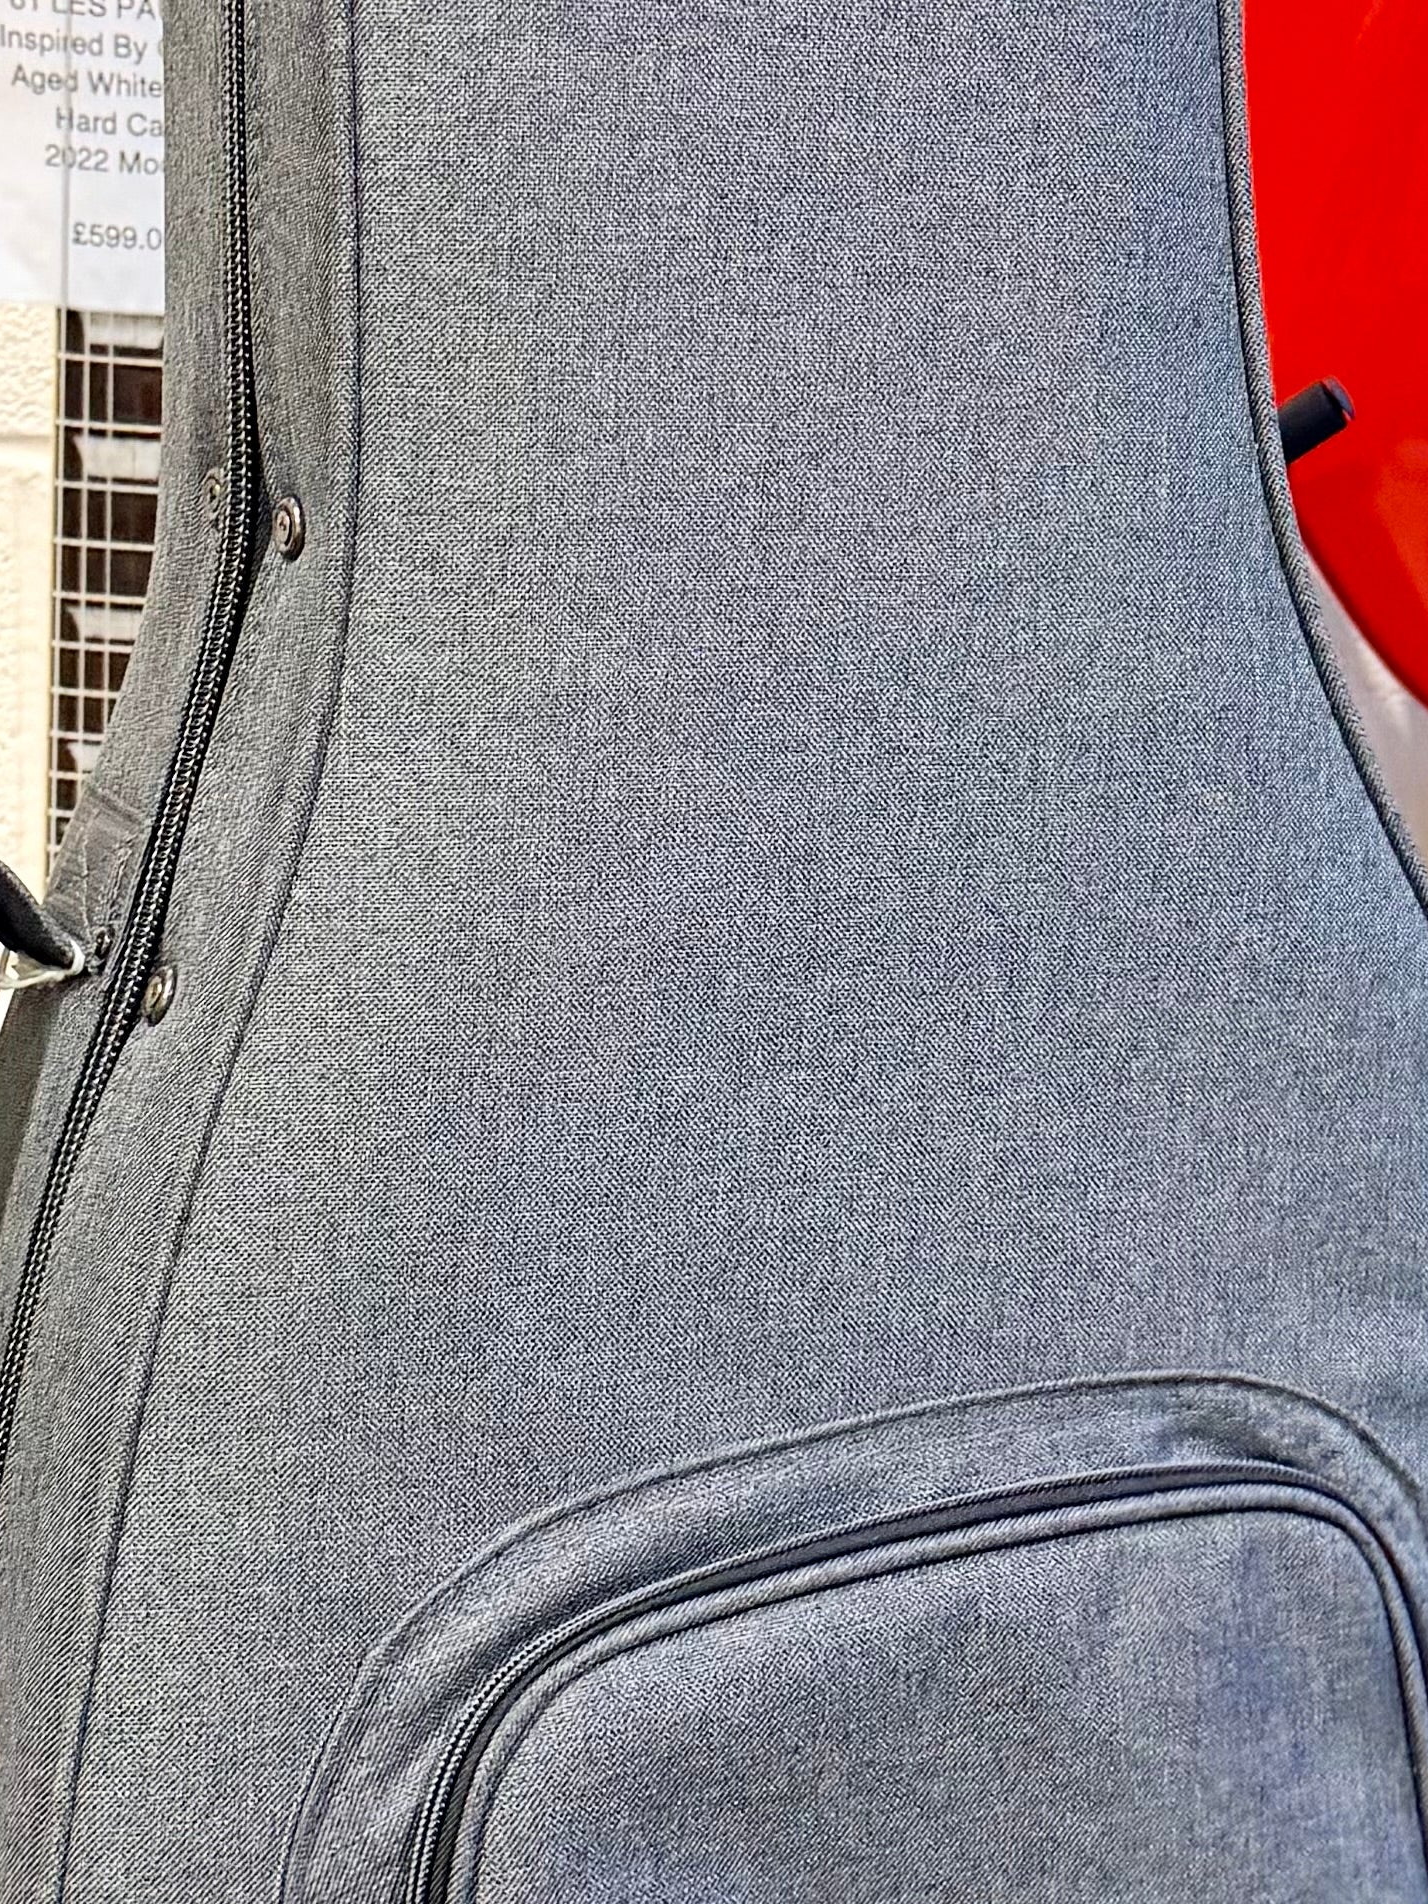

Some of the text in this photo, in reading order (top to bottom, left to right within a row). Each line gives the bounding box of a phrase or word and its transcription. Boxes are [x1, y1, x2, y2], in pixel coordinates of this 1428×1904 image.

[0, 24, 147, 66] Inspired By
[11, 64, 163, 99] Aged White
[56, 106, 116, 137] Hard
[45, 144, 164, 175] 2022 Mo
